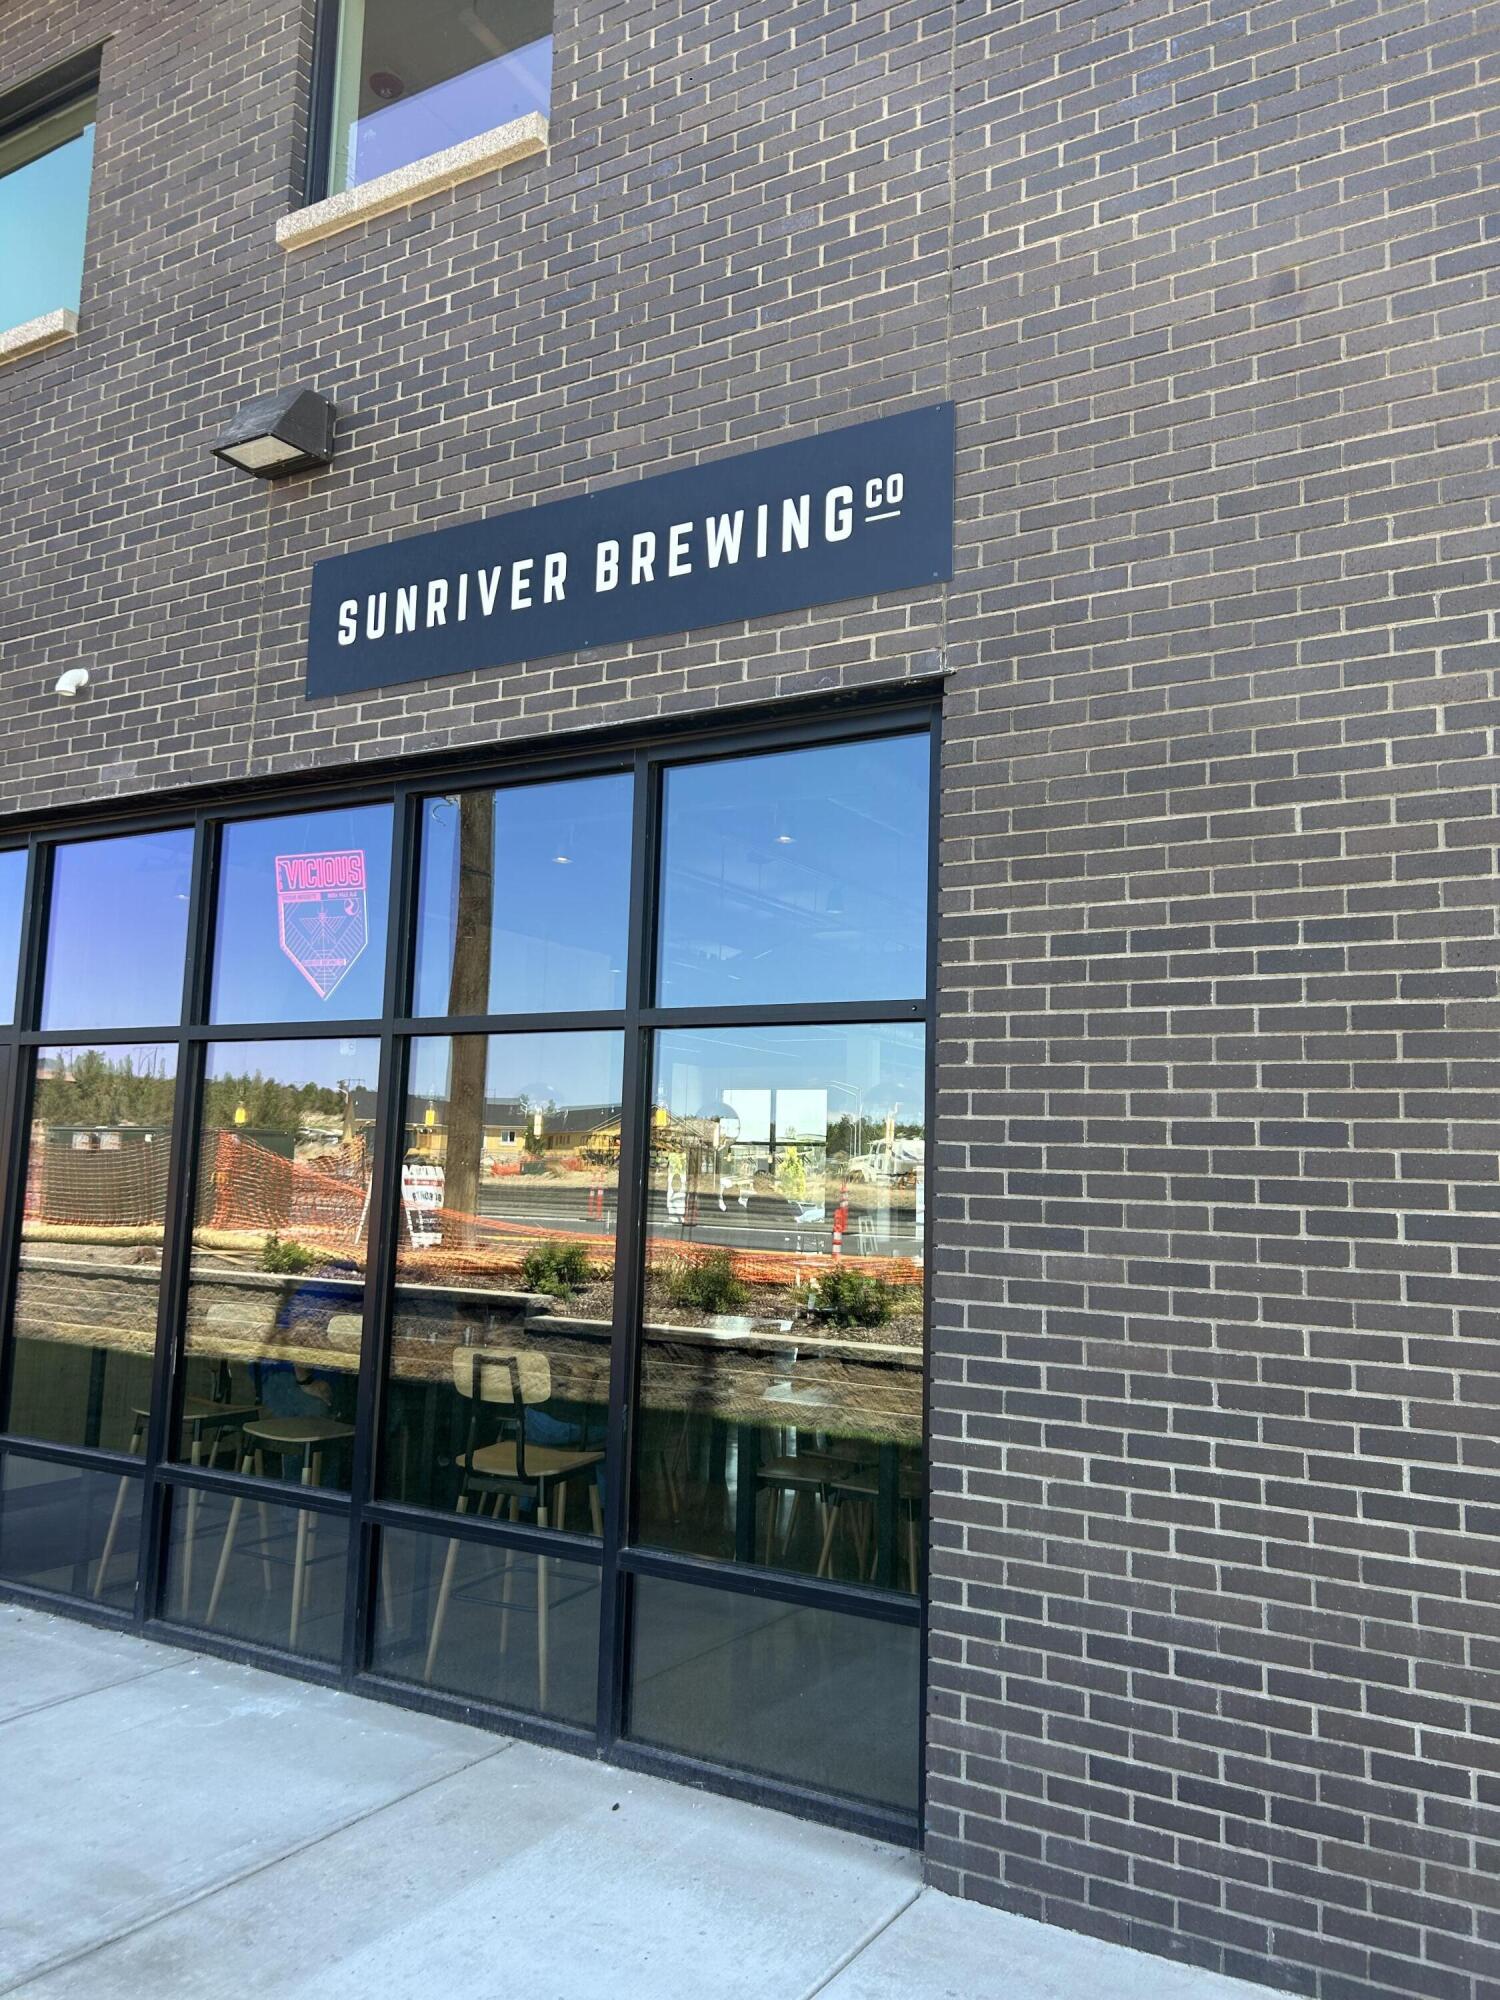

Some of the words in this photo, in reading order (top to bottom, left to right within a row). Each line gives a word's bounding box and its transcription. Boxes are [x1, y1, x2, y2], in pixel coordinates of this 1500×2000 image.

[337, 552, 567, 646] SUNRIVER
[595, 486, 853, 593] BREWING
[865, 473, 904, 509] CO
[280, 855, 362, 889] VICIOUS
